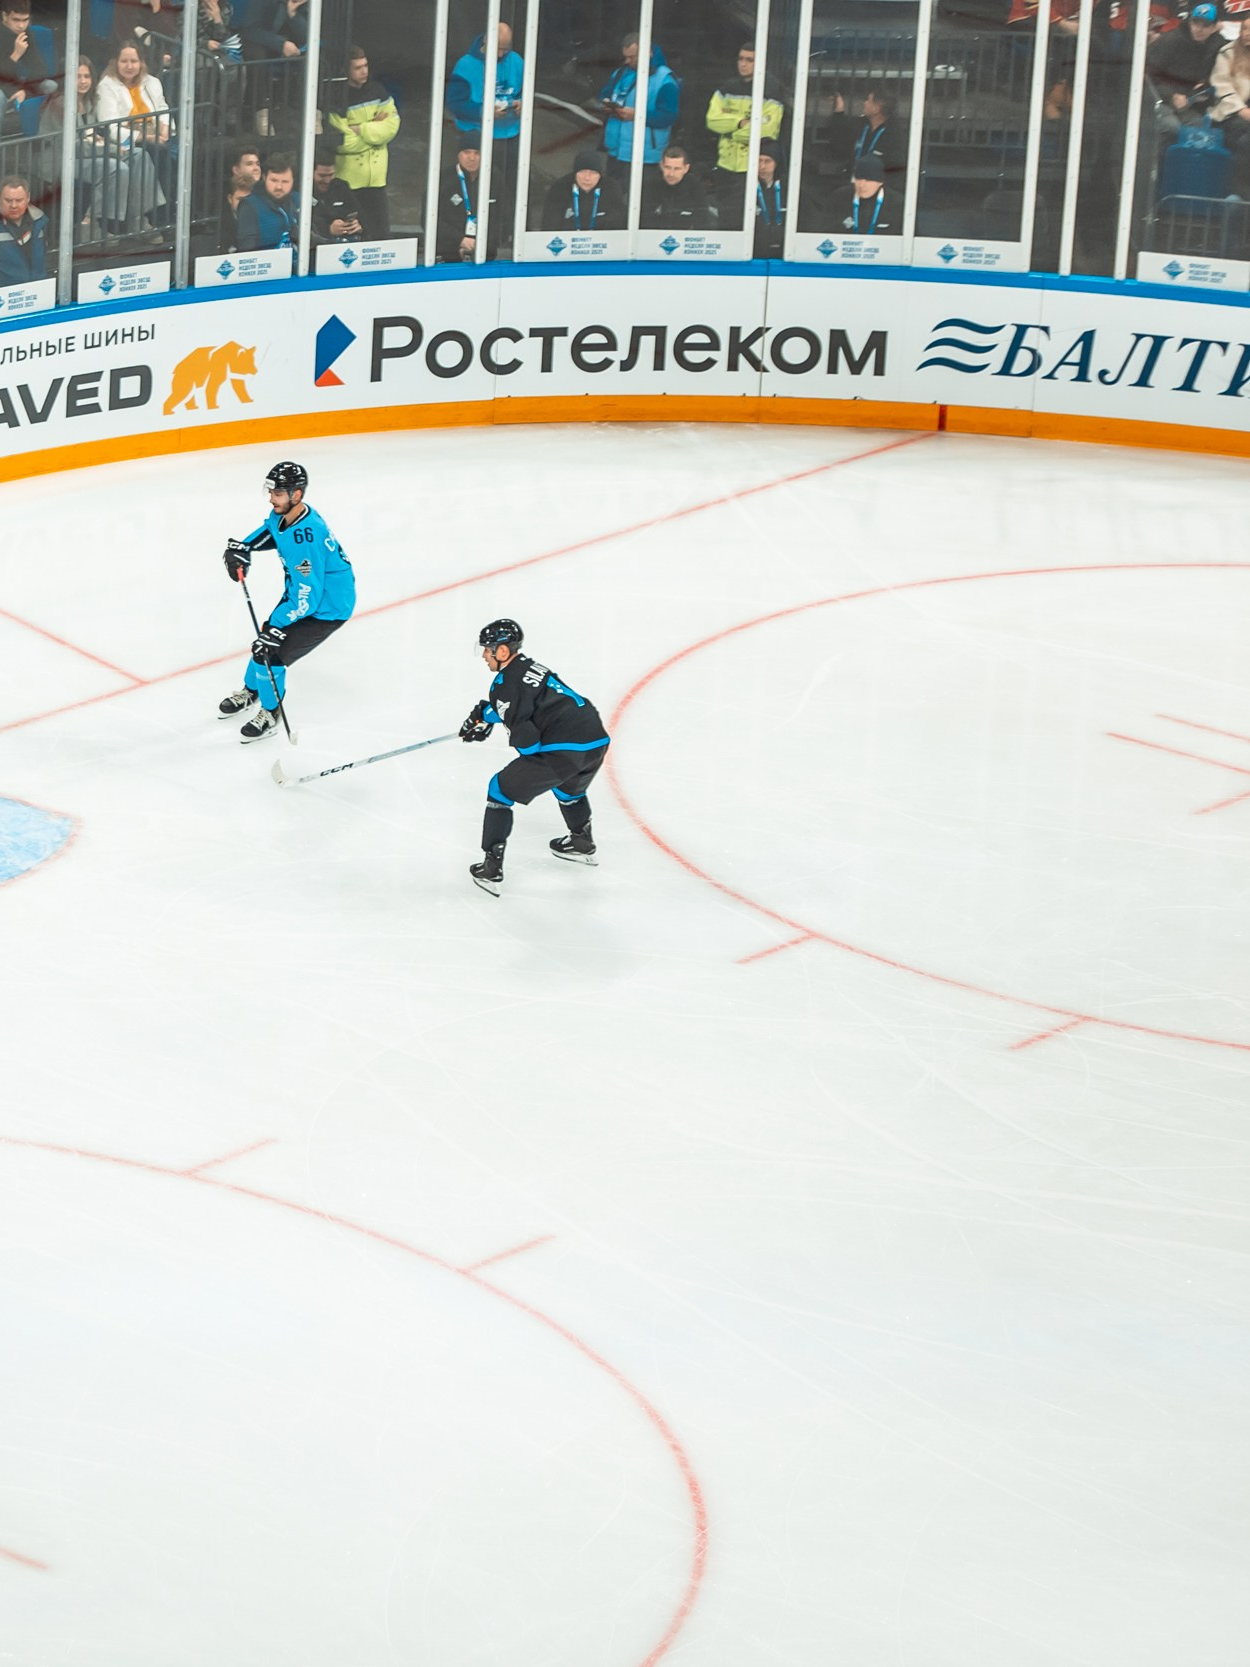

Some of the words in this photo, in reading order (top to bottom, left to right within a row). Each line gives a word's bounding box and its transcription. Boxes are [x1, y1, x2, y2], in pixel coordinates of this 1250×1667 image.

[83, 323, 156, 351] ШИНЫ
[370, 314, 889, 383] Ростелеком
[293, 526, 315, 545] 66
[319, 762, 354, 777] CCM
